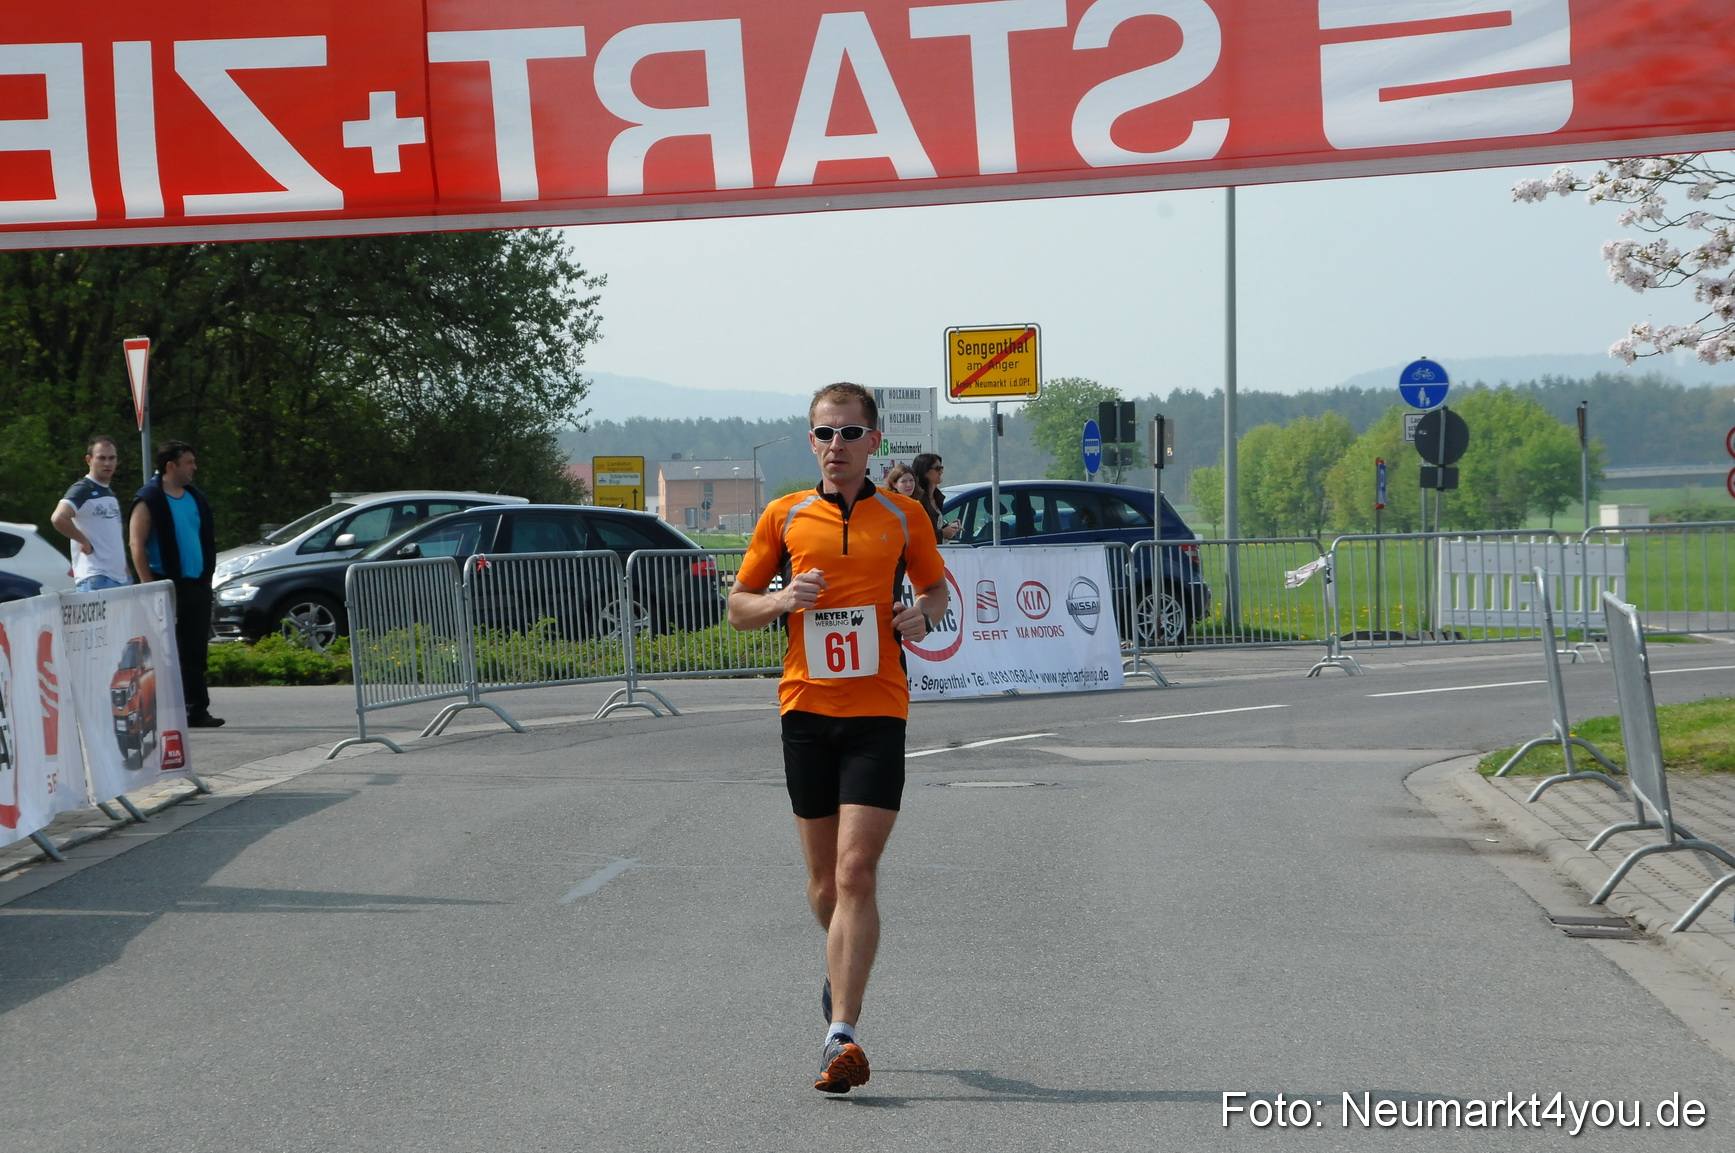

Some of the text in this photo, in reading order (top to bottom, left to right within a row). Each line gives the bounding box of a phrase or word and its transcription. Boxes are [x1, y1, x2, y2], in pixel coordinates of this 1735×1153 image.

[957, 338, 1028, 359] Sengenthal
[967, 360, 1019, 372] am Anger
[975, 379, 1007, 388] Neumarkt
[889, 390, 920, 399] HOLZAMMER
[889, 414, 921, 423] HOLZAMMER
[1022, 591, 1046, 610] KIA
[815, 611, 848, 621] MEYER
[815, 619, 849, 627] WERBUNG
[972, 630, 1008, 640] SEAT
[1016, 625, 1065, 638] KIA MOTORS
[824, 631, 860, 673] 61
[921, 673, 967, 694] Sengenthal
